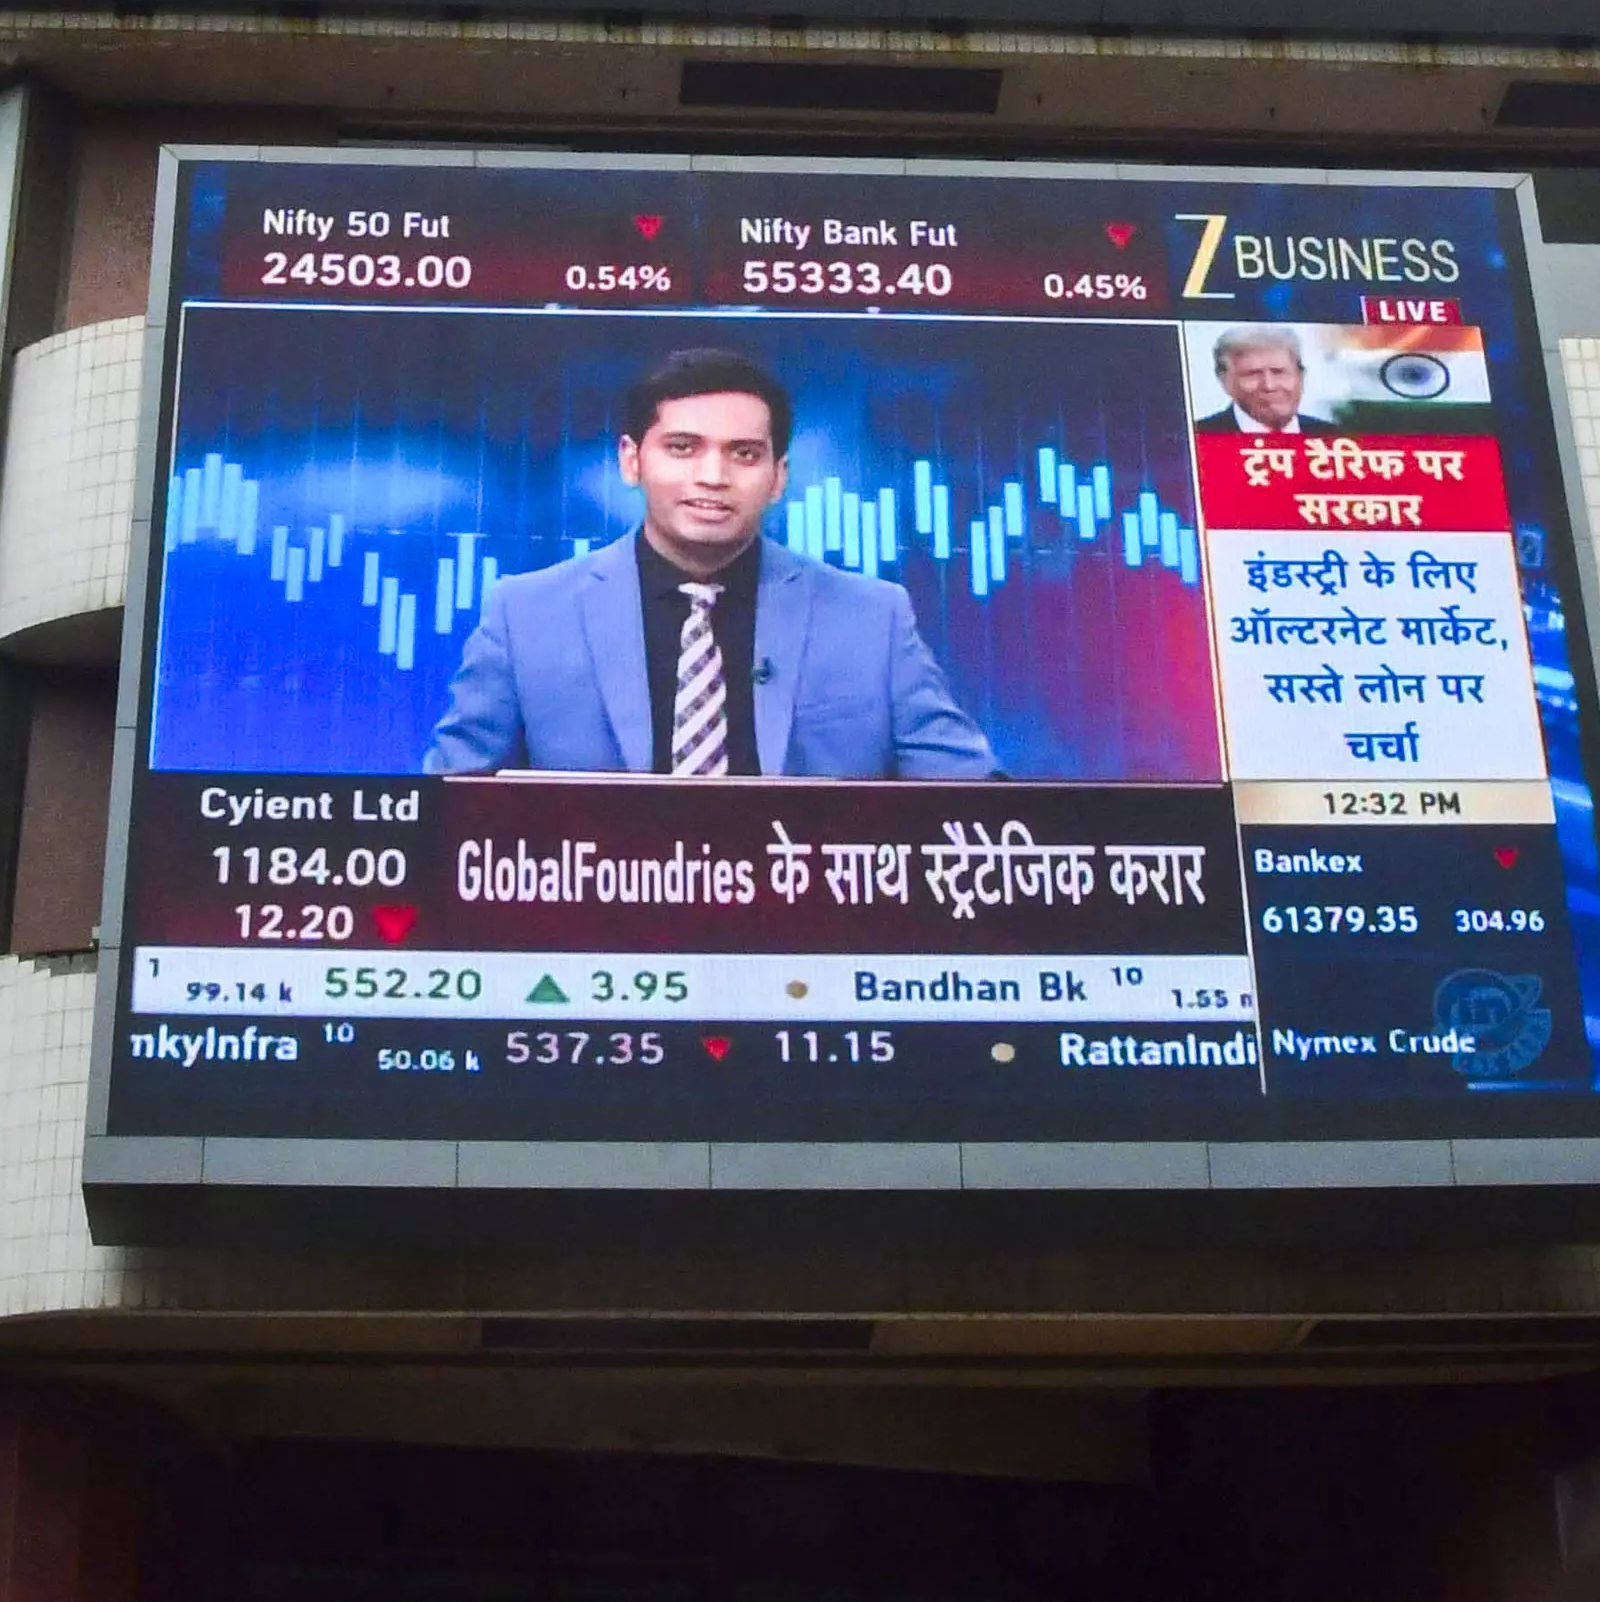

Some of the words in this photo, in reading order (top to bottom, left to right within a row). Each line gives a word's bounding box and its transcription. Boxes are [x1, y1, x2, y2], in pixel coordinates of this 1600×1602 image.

[262, 208, 335, 241] Nifty
[347, 211, 391, 239] 50
[403, 211, 451, 240] Fut
[740, 216, 811, 250] Nifty
[824, 218, 899, 248] Bank
[909, 220, 958, 248] Fut
[260, 251, 473, 289] 24503.00
[1235, 232, 1460, 284] BUSINESS
[565, 264, 672, 292] 0.54%
[741, 260, 953, 298] 55333.40
[1043, 272, 1147, 302] 0.45%
[1379, 299, 1448, 323] LIVE
[1239, 438, 1296, 487] ट्रंप
[1305, 437, 1405, 481] टैरिफ
[1413, 449, 1465, 481] पर
[1293, 494, 1424, 527] सरकार
[1243, 549, 1348, 596] इंडस्ट्री
[1360, 551, 1396, 589] के
[1407, 550, 1478, 594] लिए
[1230, 605, 1387, 646] ऑल्टरनेट
[1397, 604, 1509, 651] मार्केट,
[1264, 663, 1344, 704] सस्ते
[1355, 663, 1426, 704] लोन
[1437, 674, 1485, 704] पर
[1343, 721, 1420, 763] चर्चा
[200, 786, 333, 828] Cyient
[353, 789, 420, 822] Ltd
[1323, 791, 1409, 816] 12:32
[1420, 791, 1462, 816] PM
[212, 845, 407, 887] 1184.00
[457, 838, 754, 904] GlobalFoundries
[766, 820, 813, 904] के
[820, 843, 912, 905] साथ
[1103, 844, 1207, 906] करार
[1254, 849, 1364, 875] Bankex
[235, 904, 355, 941] 12.20
[1262, 906, 1419, 935] 61379.35
[1454, 910, 1546, 934] 304.96
[186, 981, 266, 1003] 99.14
[325, 966, 483, 1002] 552.20
[591, 970, 689, 1002] 3.95
[854, 970, 1021, 1003] Bandhan
[1039, 971, 1088, 1003] Bk
[1110, 965, 1144, 987] 10
[322, 1021, 355, 1044] 10
[377, 1049, 456, 1072] 50.06
[505, 1030, 666, 1066] 537.35
[775, 1031, 896, 1064] 11.15
[1271, 1028, 1378, 1063] Nymex
[1388, 1028, 1477, 1054] Crude
